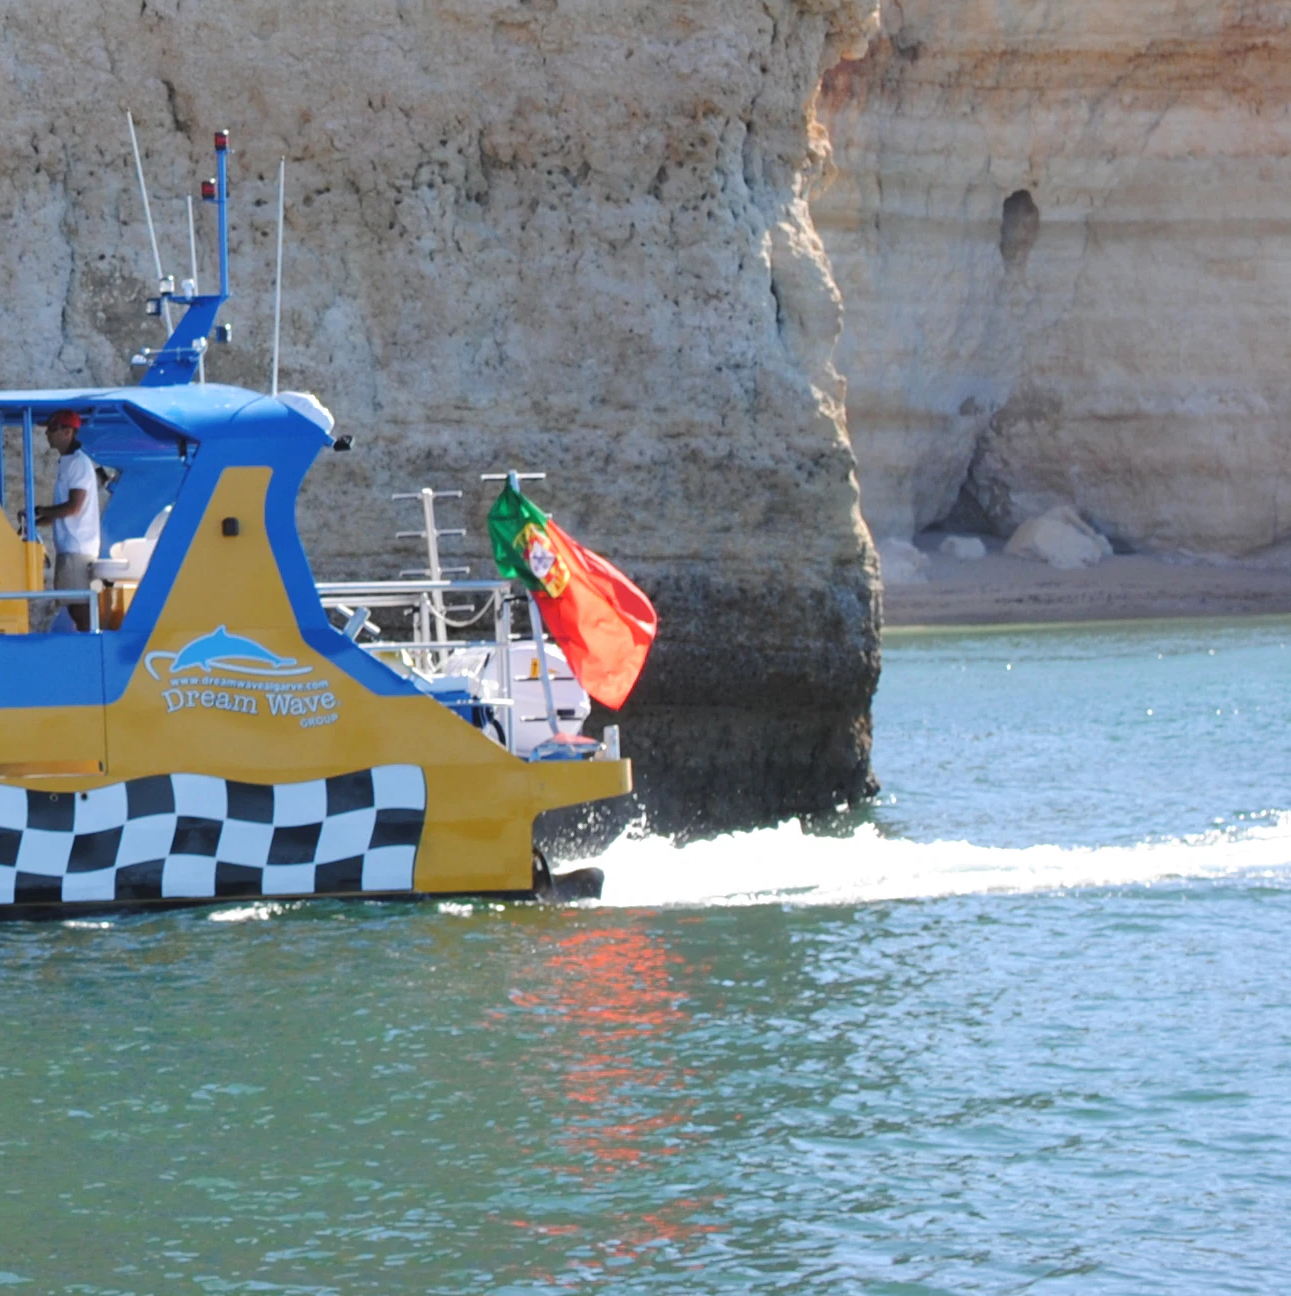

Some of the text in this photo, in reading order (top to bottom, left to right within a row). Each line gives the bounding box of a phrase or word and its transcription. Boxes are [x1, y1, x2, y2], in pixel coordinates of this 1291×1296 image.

[169, 675, 329, 692] www.dreamwavealgarve.com
[161, 687, 337, 716] Dream Wave
[299, 712, 339, 729] GROUP
